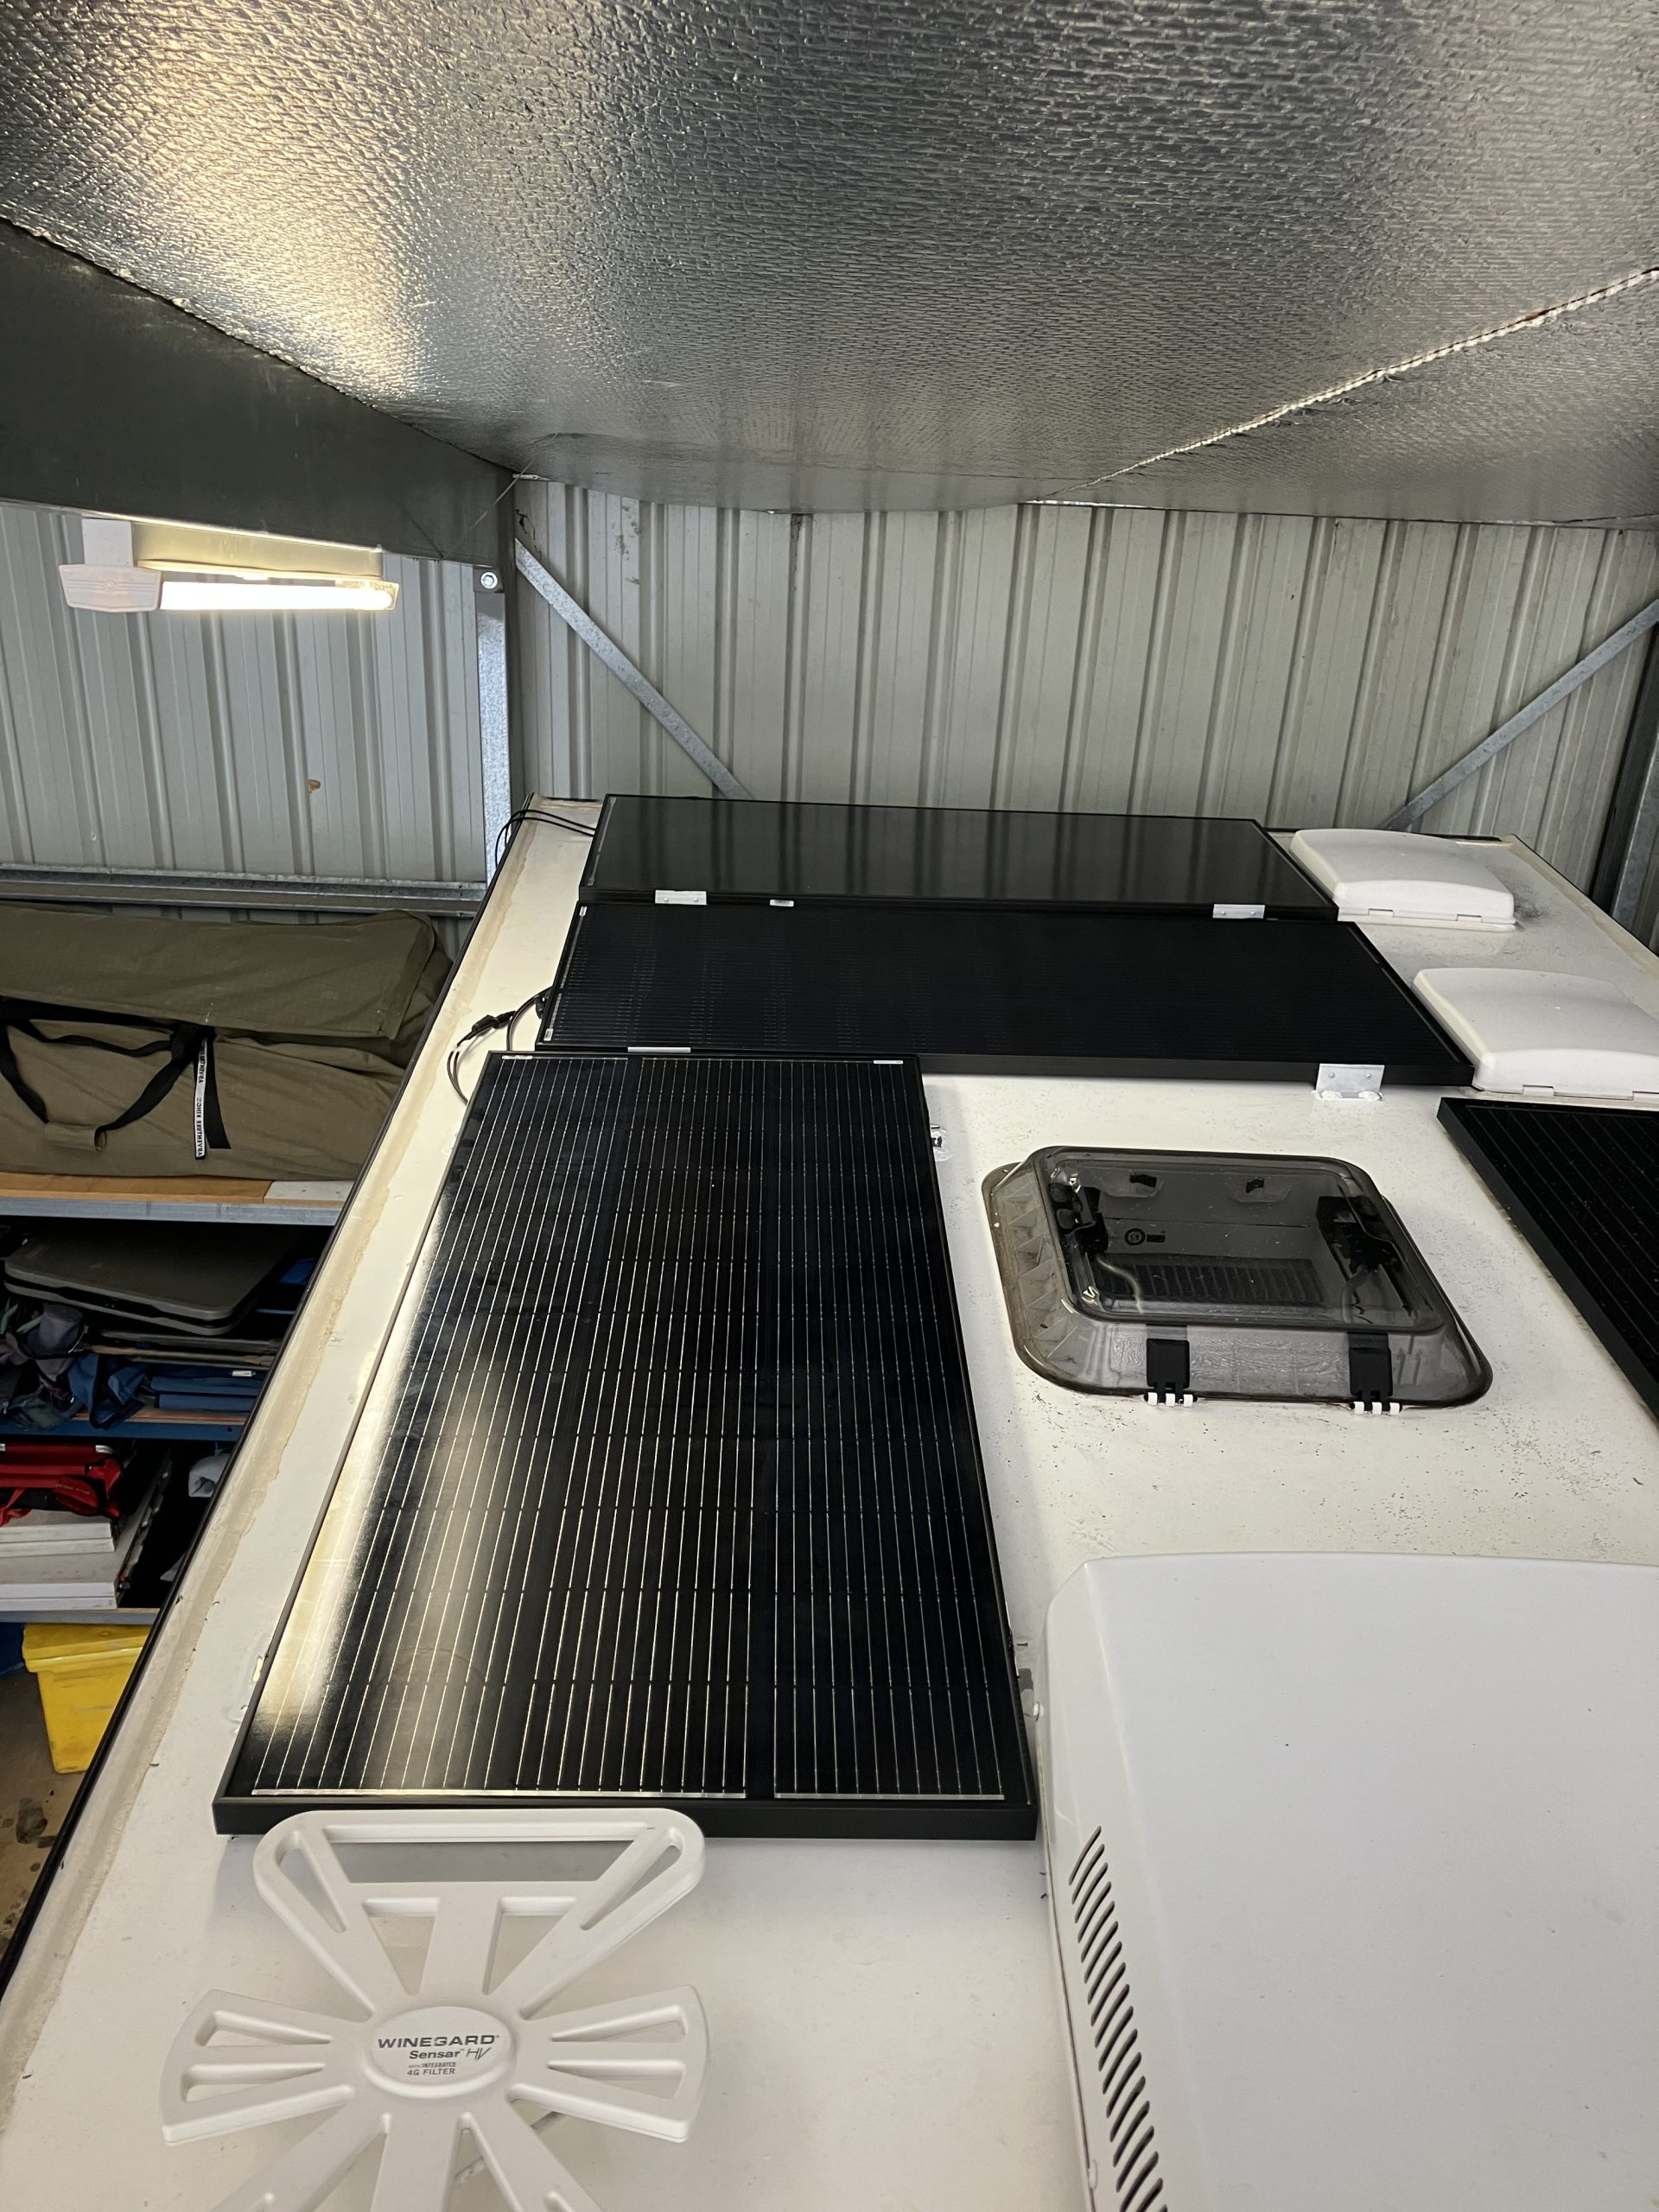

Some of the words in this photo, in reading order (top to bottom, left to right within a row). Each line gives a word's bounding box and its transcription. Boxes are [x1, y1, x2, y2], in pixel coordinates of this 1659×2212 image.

[378, 2035, 495, 2049] WINEGARD
[409, 2050, 461, 2060] Sensar
[467, 2047, 492, 2061] HV
